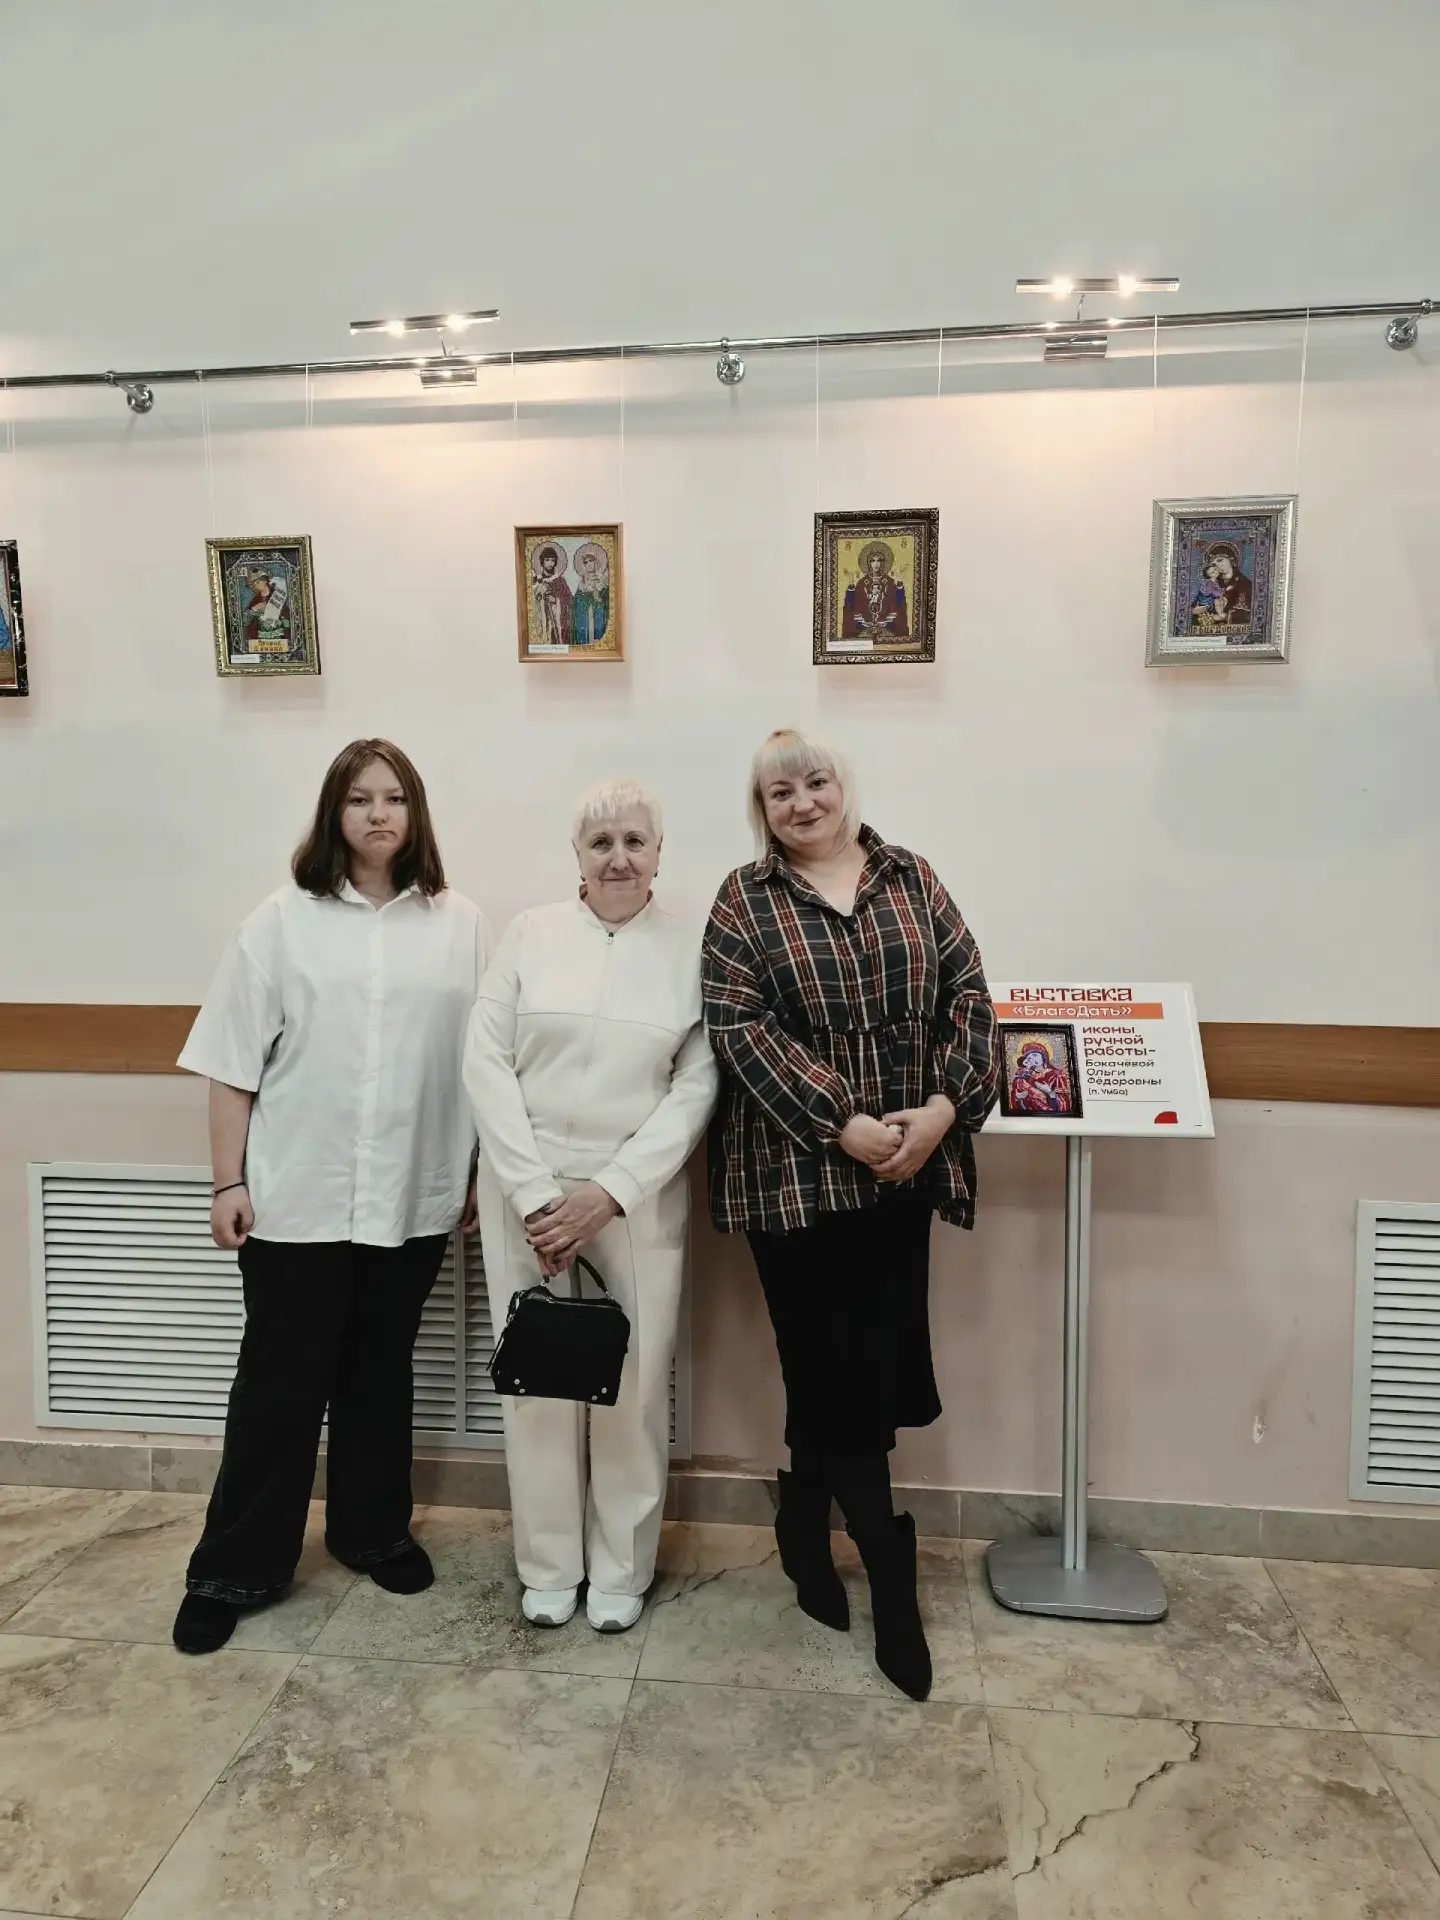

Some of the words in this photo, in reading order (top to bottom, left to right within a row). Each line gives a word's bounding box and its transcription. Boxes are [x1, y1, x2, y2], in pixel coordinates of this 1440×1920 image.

[1012, 1005, 1133, 1018] «БлагоДать»
[1082, 1027, 1135, 1035] иконы
[1083, 1035, 1144, 1047] ручной
[1086, 1068, 1126, 1076] Ольги
[1087, 1077, 1162, 1087] Фёдоровны
[1088, 1088, 1100, 1096] (п.
[1101, 1088, 1129, 1097] Умба)
